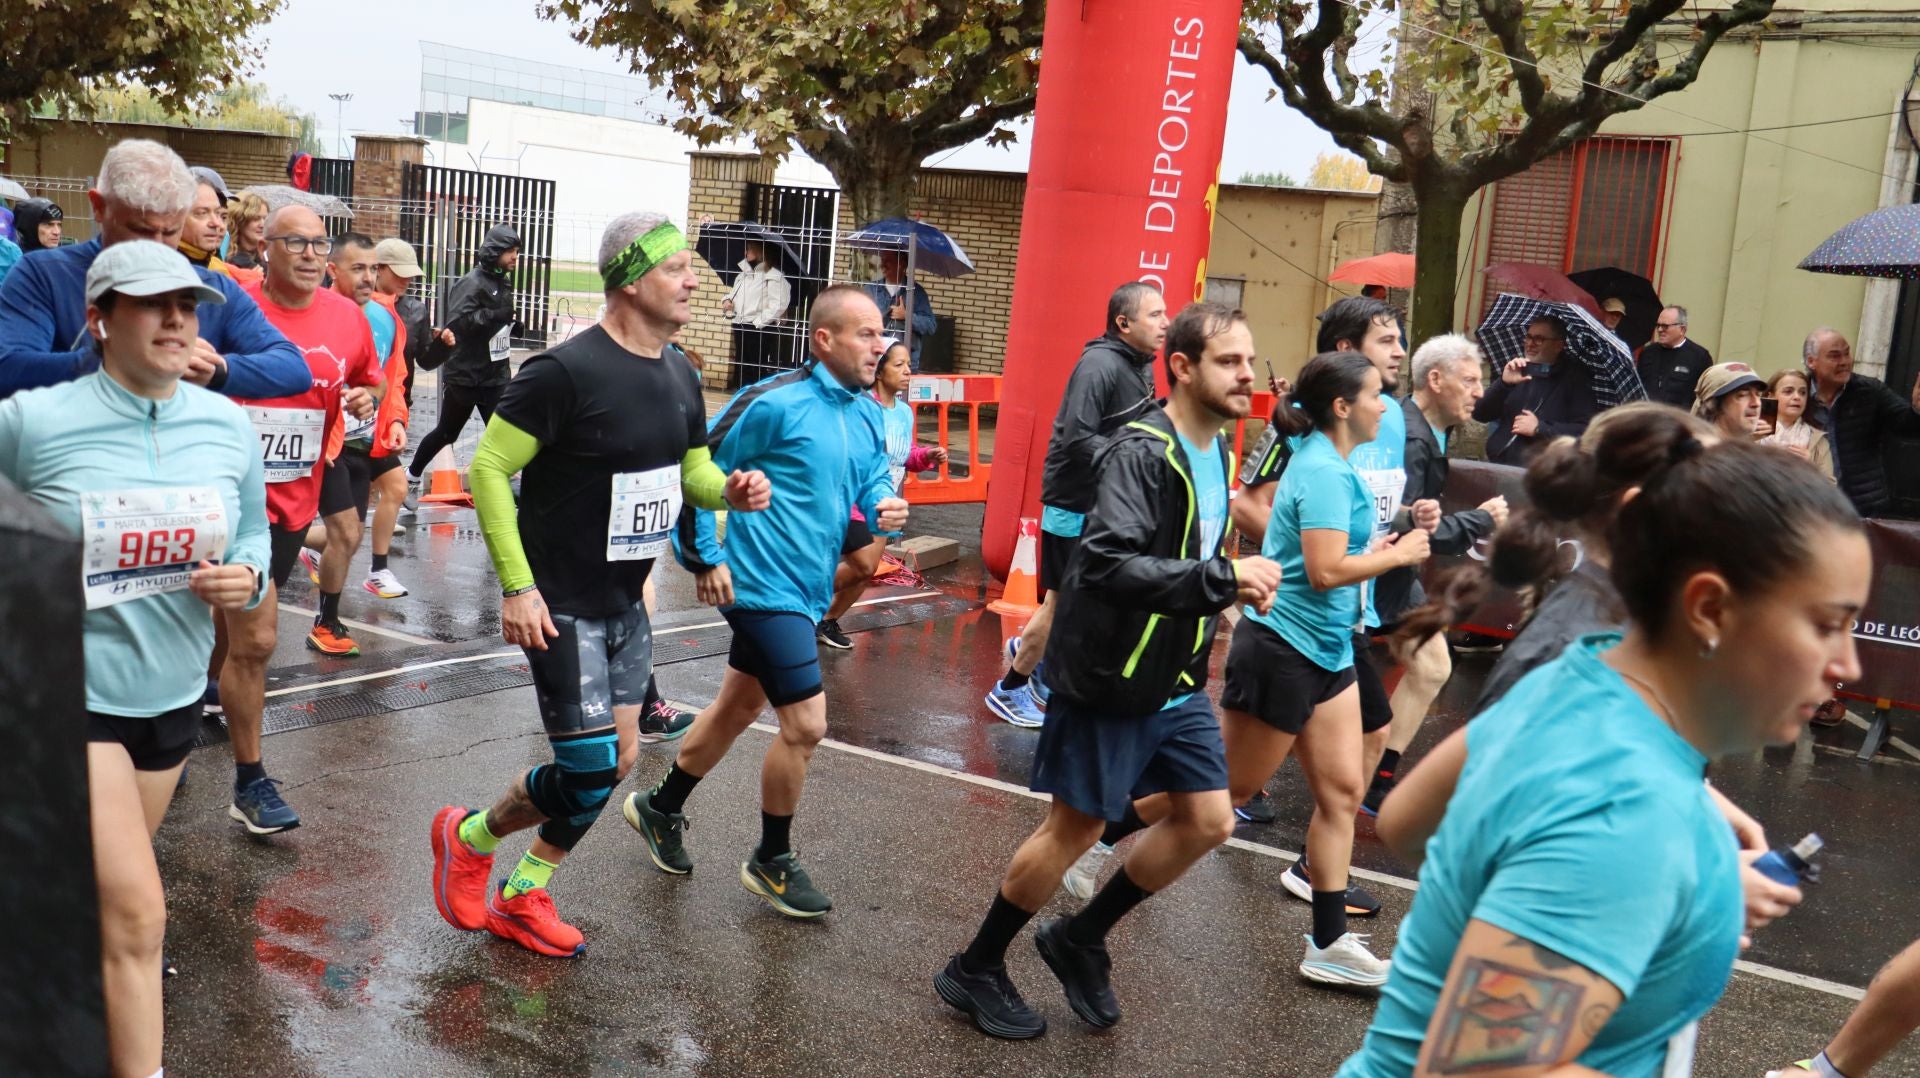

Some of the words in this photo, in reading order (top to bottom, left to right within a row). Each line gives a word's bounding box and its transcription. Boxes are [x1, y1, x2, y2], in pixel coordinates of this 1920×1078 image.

[1144, 16, 1204, 233] DEPORTES
[261, 433, 303, 460] 740
[114, 518, 147, 529] MARTA
[153, 515, 202, 527] IGLESIAS
[632, 499, 669, 533] 670
[118, 528, 196, 569] 963
[1863, 621, 1886, 635] DE
